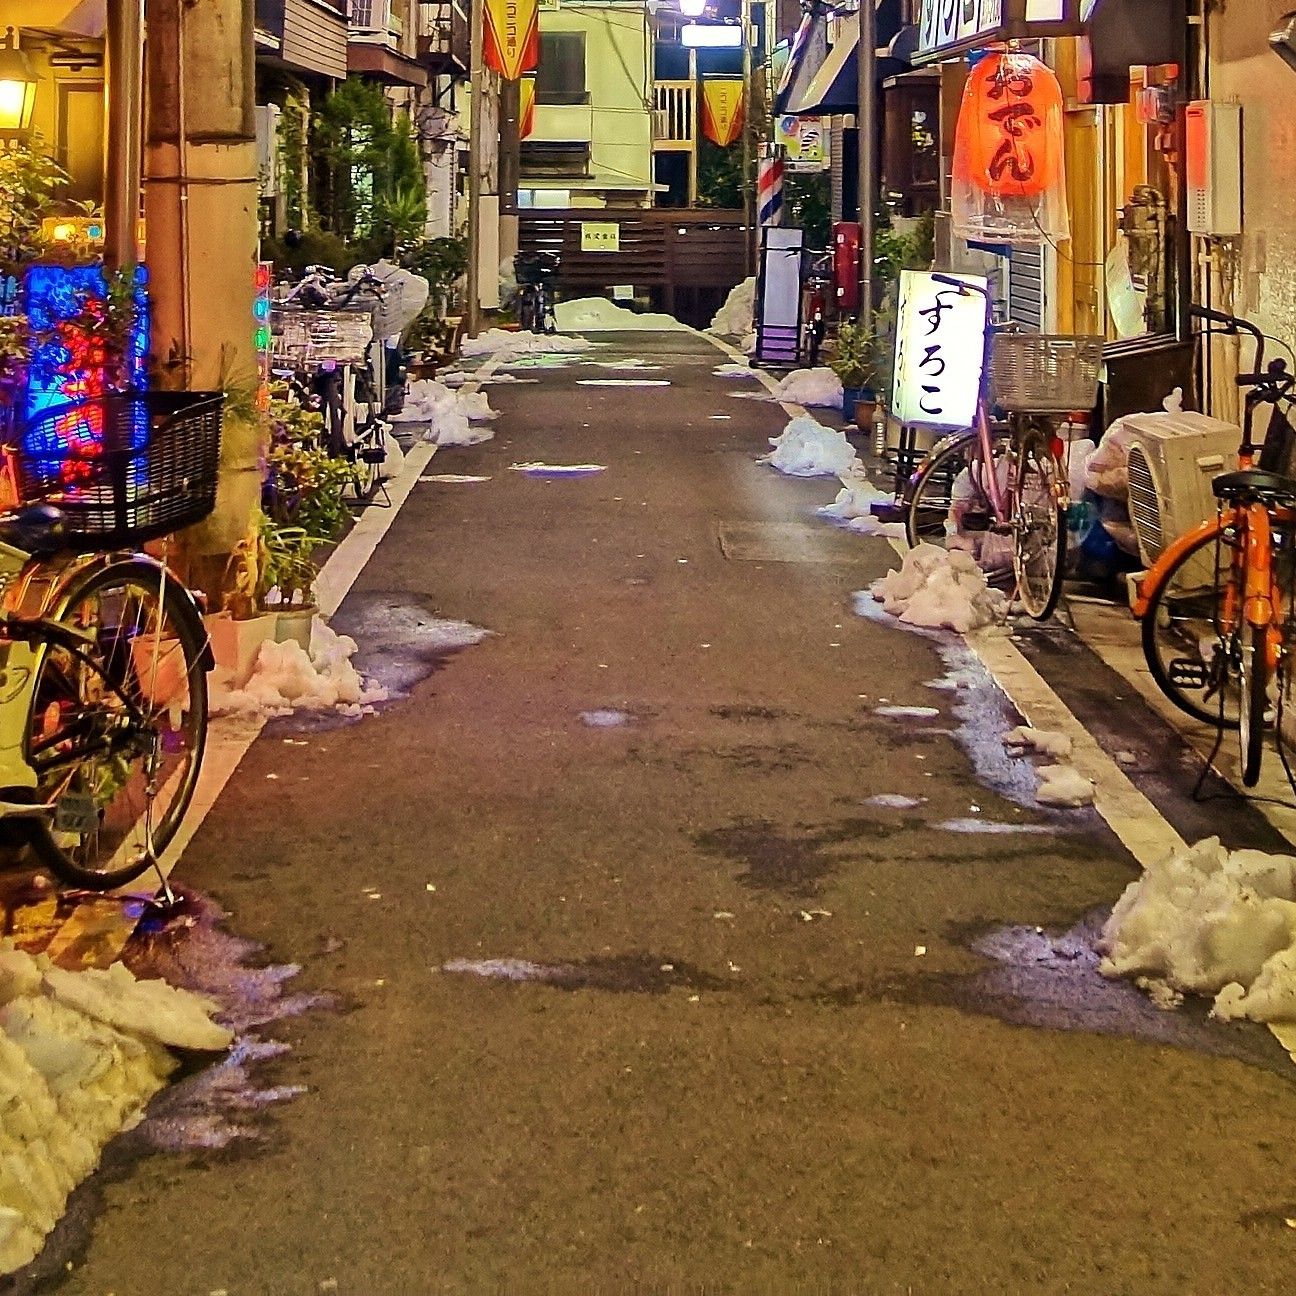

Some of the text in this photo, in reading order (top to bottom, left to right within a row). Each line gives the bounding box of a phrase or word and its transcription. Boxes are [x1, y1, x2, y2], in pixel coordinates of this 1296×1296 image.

[985, 65, 1042, 182] おでん
[919, 290, 954, 415] すろこ
